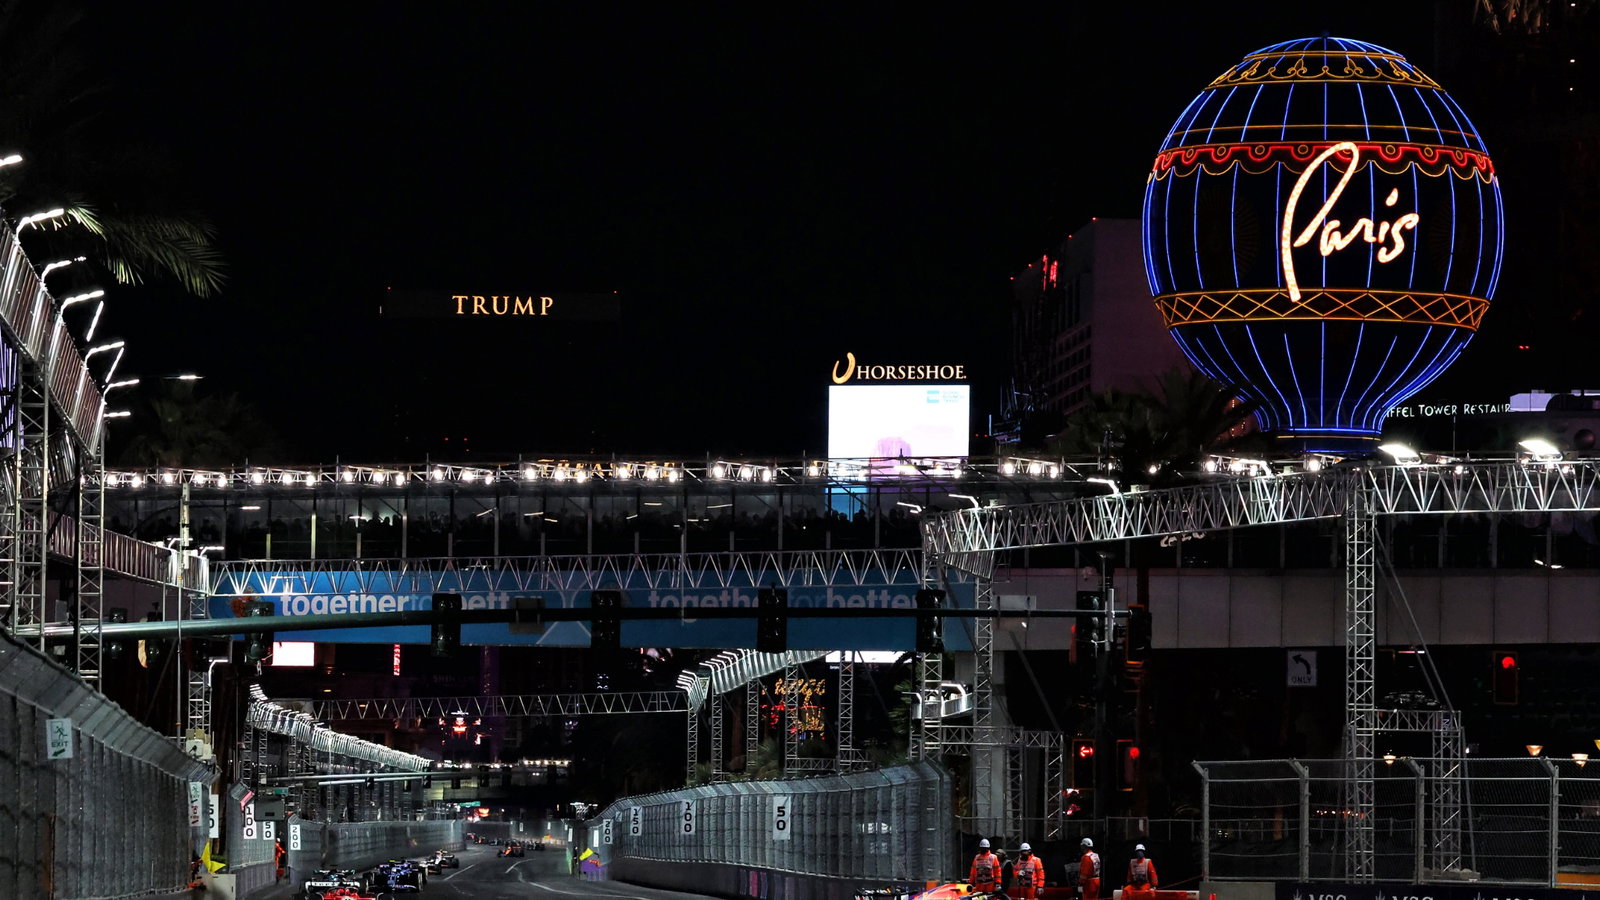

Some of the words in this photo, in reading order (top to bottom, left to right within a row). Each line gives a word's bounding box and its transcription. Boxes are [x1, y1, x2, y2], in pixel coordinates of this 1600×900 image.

[1282, 141, 1419, 302] Paris
[452, 295, 554, 315] TRUMP
[1386, 406, 1416, 418] IFFEL
[1418, 404, 1458, 417] TOWER
[1291, 675, 1312, 684] ONLY
[51, 740, 69, 748] EXIT
[246, 806, 254, 837] 100
[684, 802, 692, 832] 100
[776, 806, 786, 831] 50
